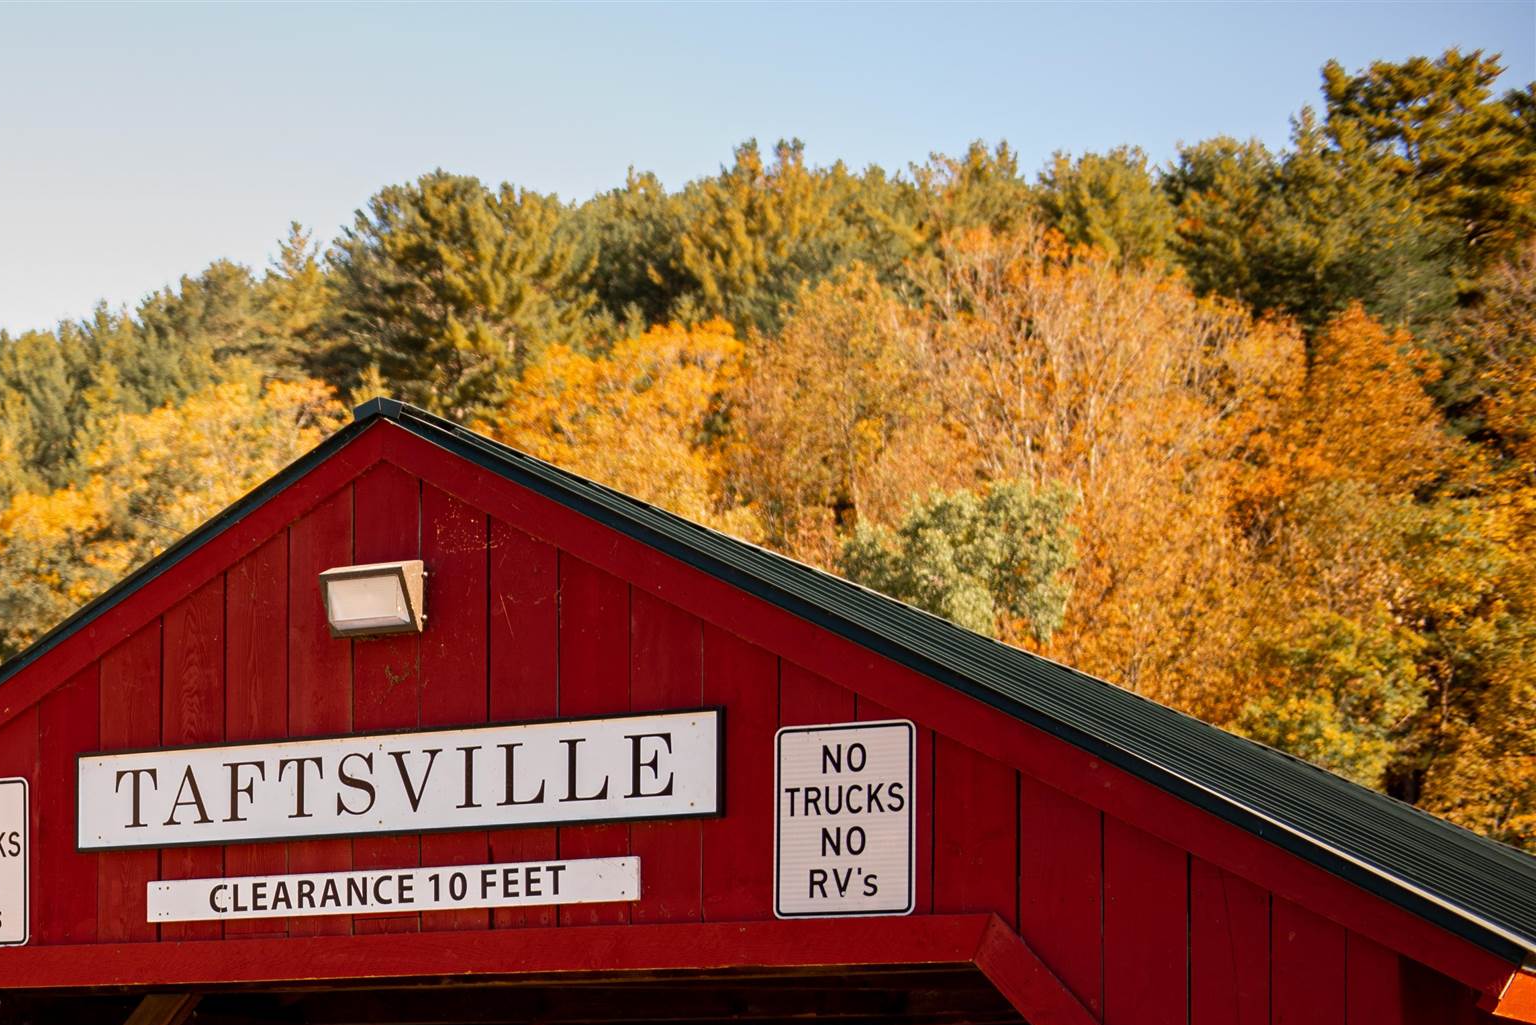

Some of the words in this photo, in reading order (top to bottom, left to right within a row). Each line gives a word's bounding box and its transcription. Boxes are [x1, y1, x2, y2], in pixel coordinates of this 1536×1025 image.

[820, 742, 867, 775] NO
[115, 732, 675, 829] TAFTSVILLE
[784, 782, 905, 817] TRUCKS
[821, 825, 867, 857] NO
[209, 873, 415, 913] CLEARANCE
[428, 872, 468, 902] 10
[480, 864, 566, 900] FEET
[808, 867, 878, 899] RV's
